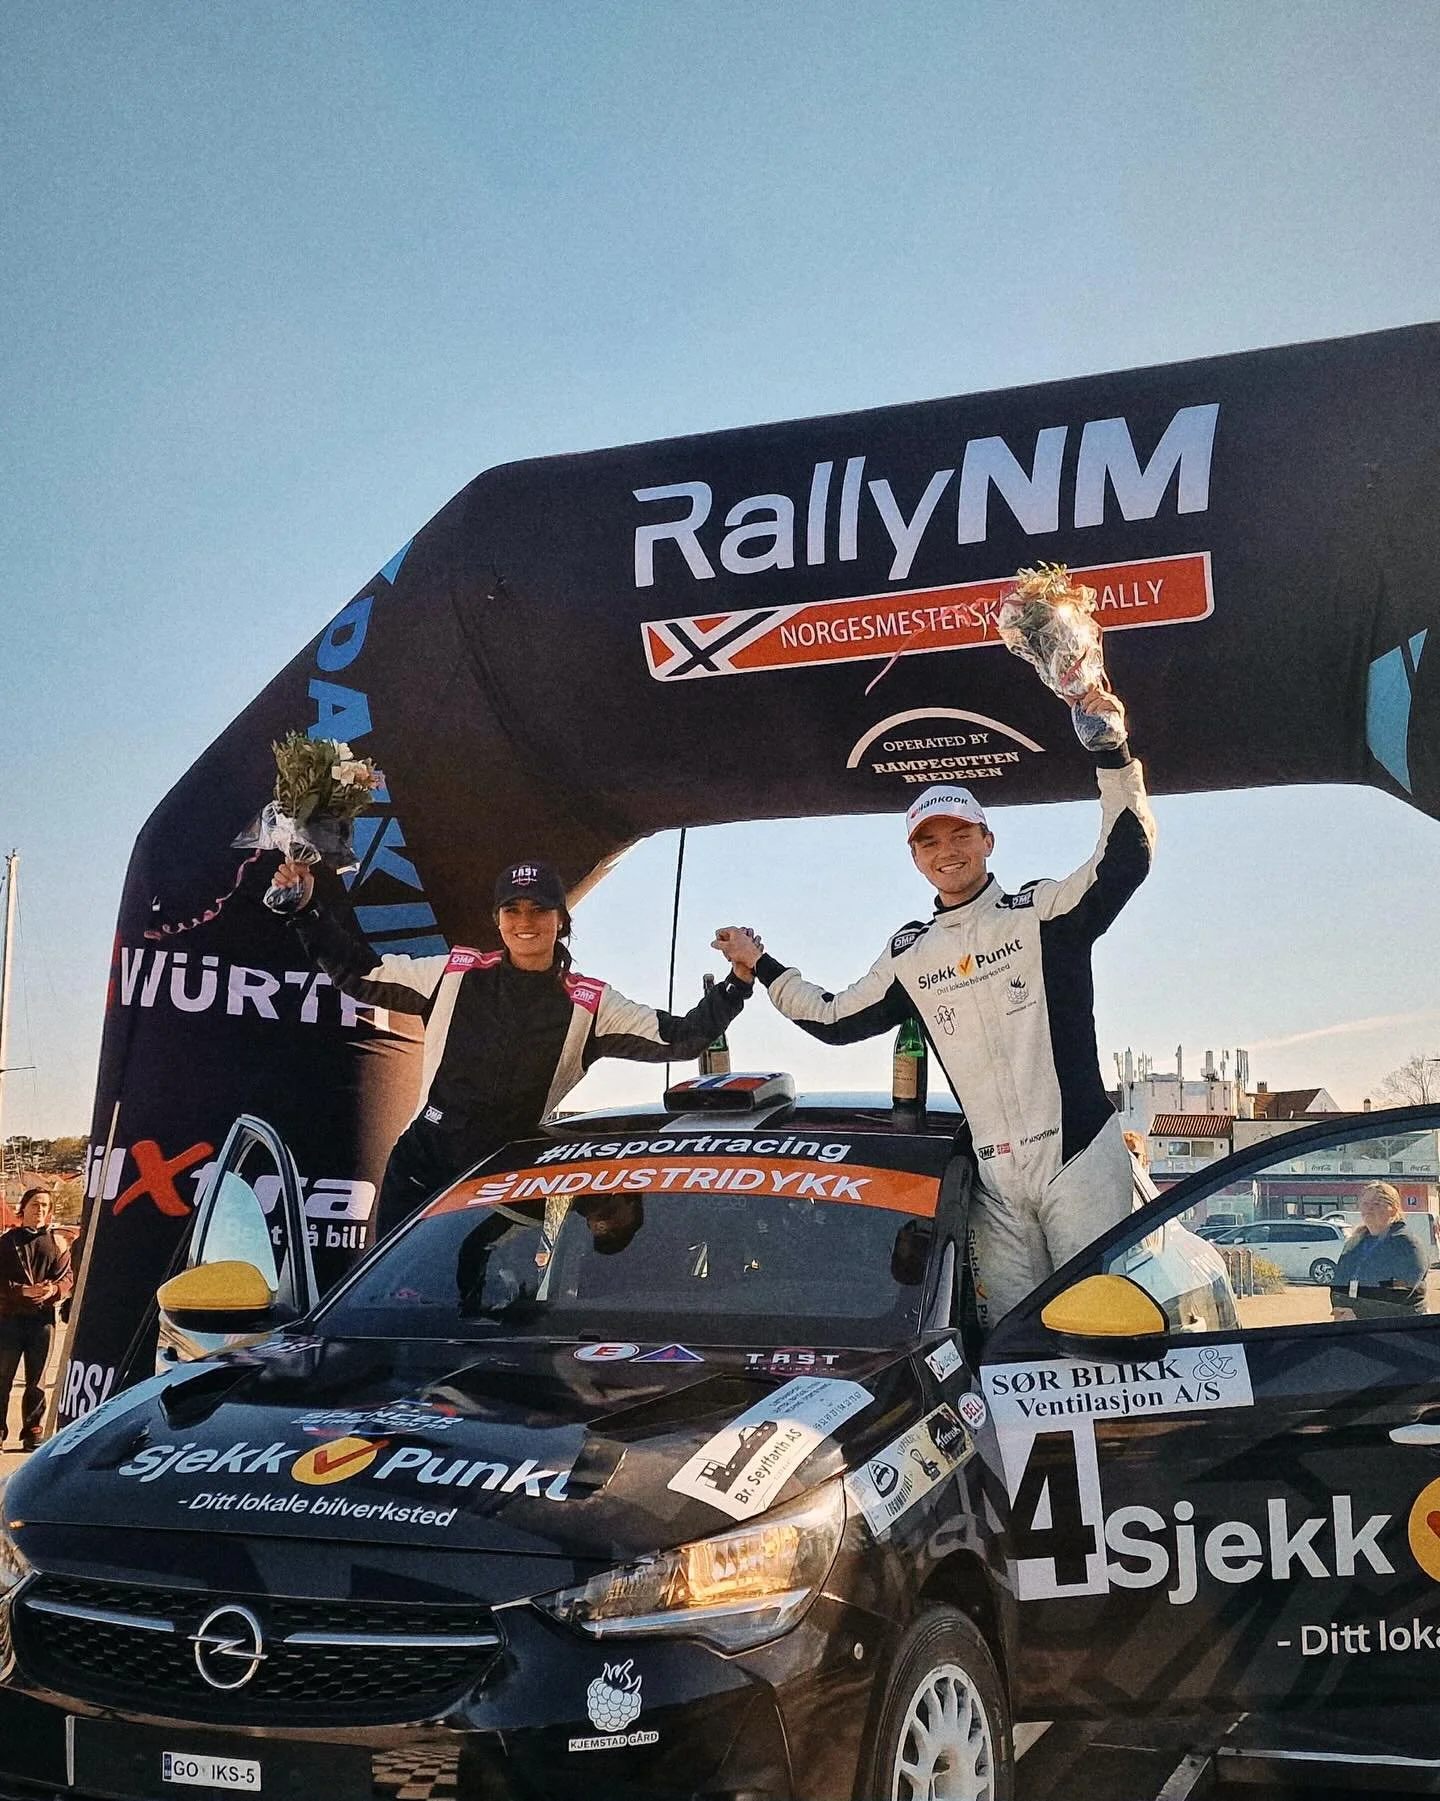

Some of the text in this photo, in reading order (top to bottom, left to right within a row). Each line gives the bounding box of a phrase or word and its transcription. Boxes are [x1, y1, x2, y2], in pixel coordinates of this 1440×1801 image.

[633, 403, 1219, 587] RallyNM
[883, 733, 989, 752] OPERATED BY
[872, 751, 1020, 774] RAMPEGUTTEN
[902, 767, 1003, 783] BREDESEN
[451, 953, 475, 966] OMP
[918, 938, 1023, 990] Sjekk Punkt
[573, 988, 596, 1002] OMP
[425, 1107, 442, 1123] OMP
[534, 1135, 852, 1165] #iksportracing
[509, 1167, 872, 1200] INDUSTRIDYKK
[326, 1226, 367, 1249] bil!
[992, 1348, 1237, 1396] SØR BLIKK &
[962, 1398, 983, 1419] BELL
[1016, 1389, 1163, 1419] Ventilasjon
[1174, 1381, 1221, 1404] A/S
[300, 1410, 464, 1425] SPENCER
[119, 1442, 300, 1483] Sjekk
[734, 1487, 754, 1505] Br.
[747, 1441, 791, 1486] Seyffarth
[785, 1428, 802, 1444] AS
[235, 1493, 309, 1514] lokale
[308, 1496, 458, 1528] bilverksted
[1005, 1430, 1097, 1587] 4
[1105, 1494, 1396, 1604] Sjekk
[1379, 1618, 1440, 1651] lok
[570, 1731, 658, 1750] KJEMSTAD GÅRD
[173, 1760, 255, 1784] GO IKS-5
